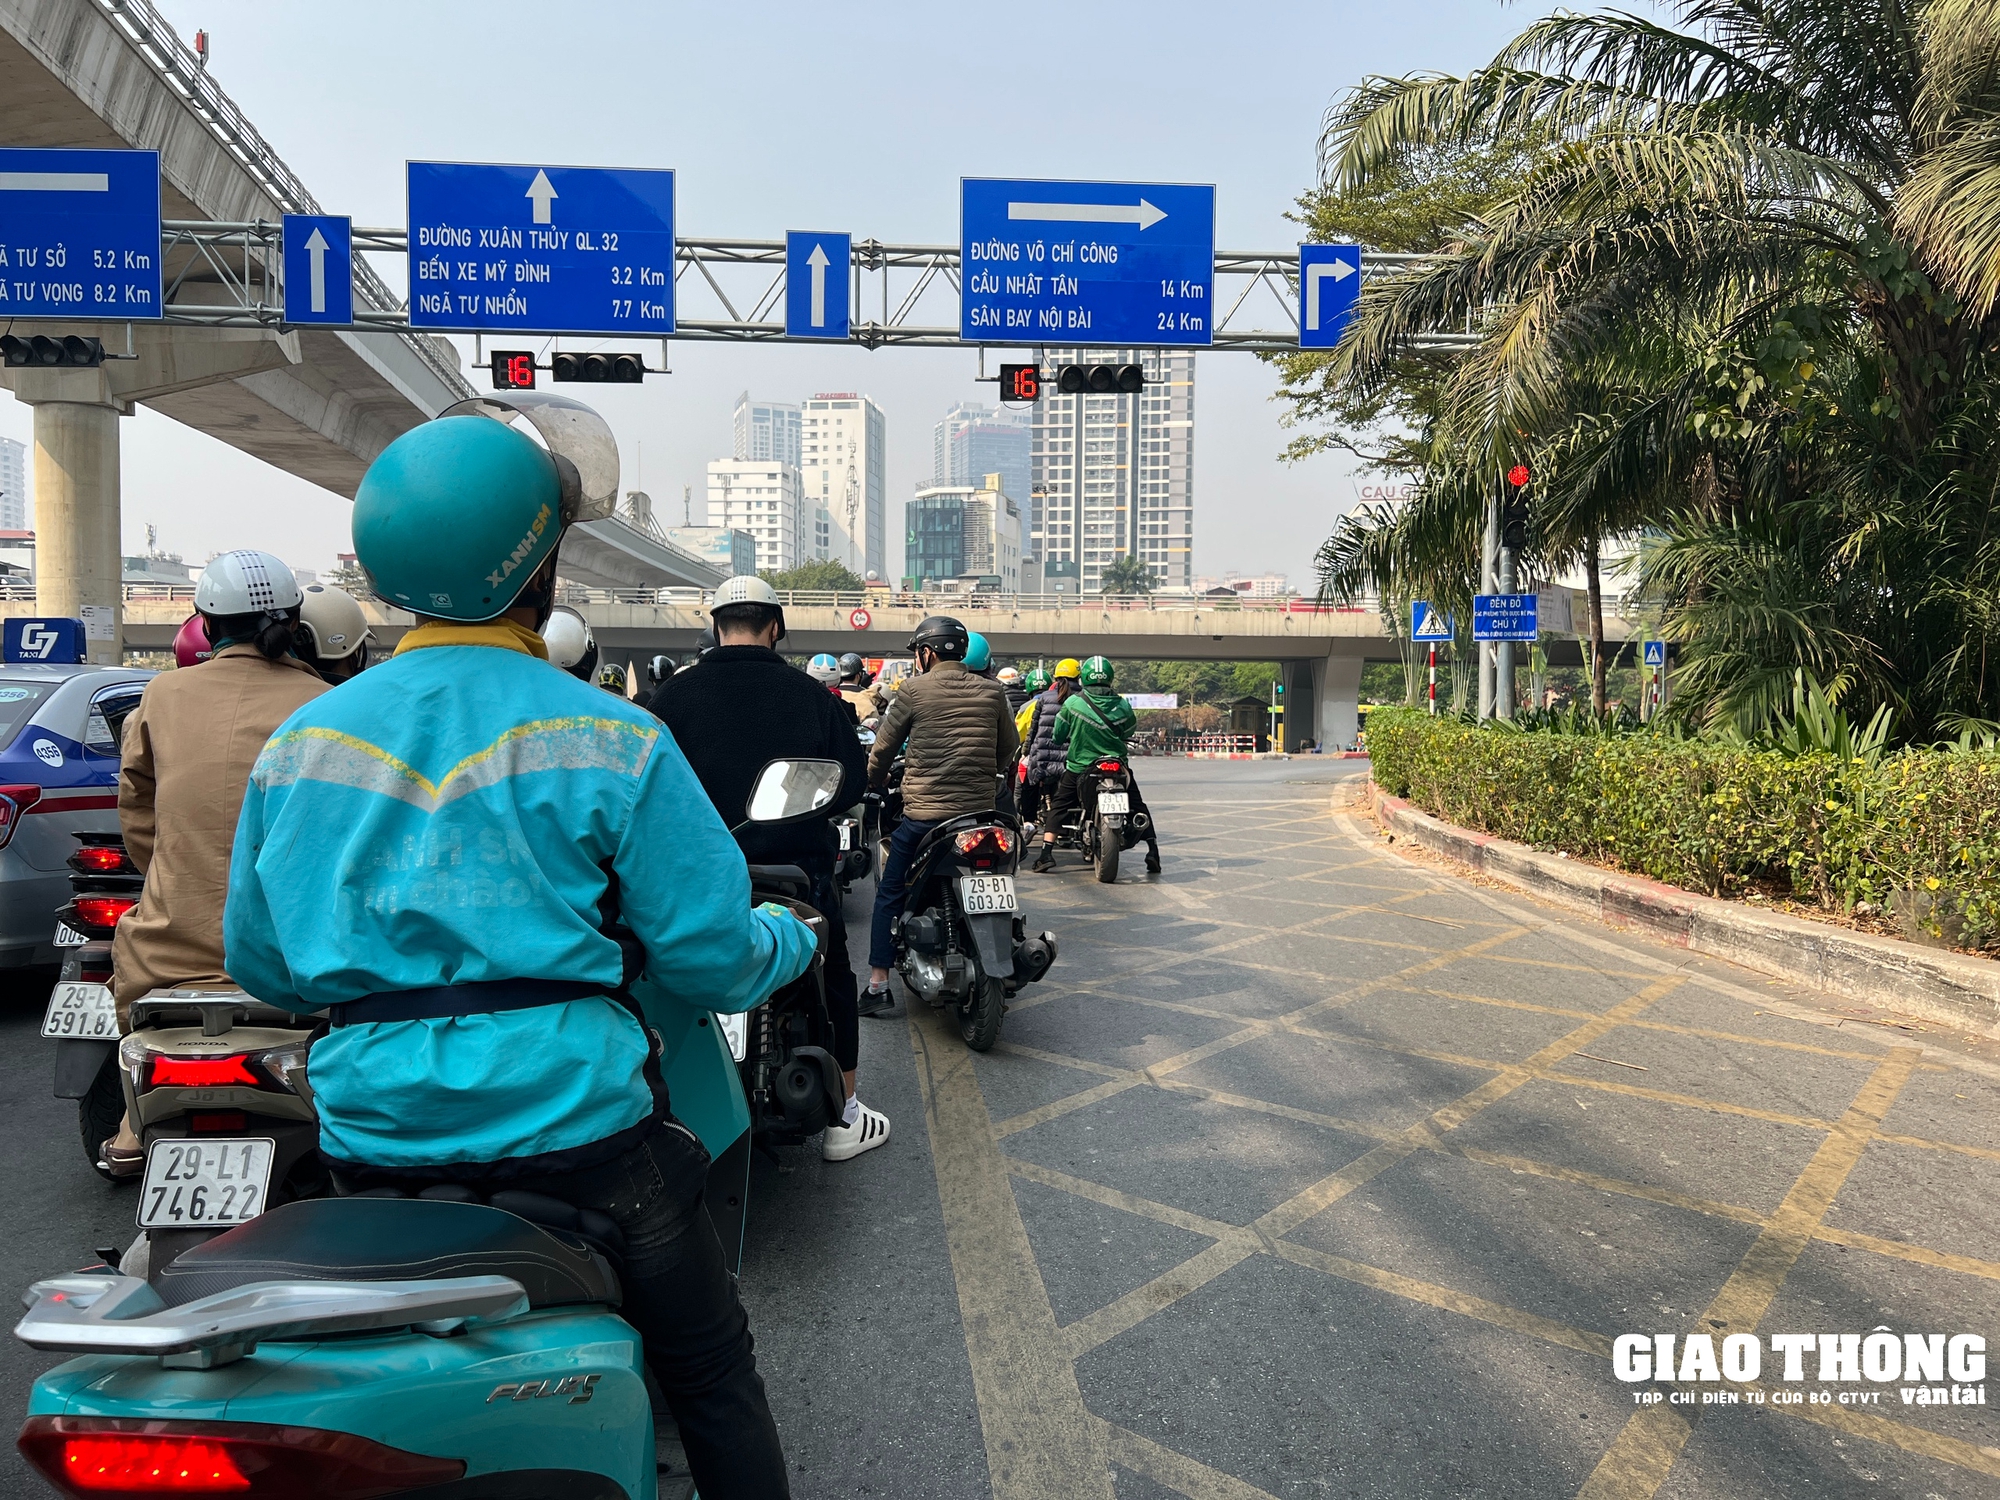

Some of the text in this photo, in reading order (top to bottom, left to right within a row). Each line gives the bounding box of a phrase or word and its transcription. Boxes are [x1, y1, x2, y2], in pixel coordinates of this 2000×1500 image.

[419, 223, 472, 247] ĐƯỜNG
[479, 226, 522, 249] XUÂN
[529, 225, 569, 250] THỦY
[16, 247, 38, 268] TƯ
[45, 242, 67, 268] SỞ
[94, 250, 116, 269] 5.2
[125, 250, 150, 269] Km
[971, 238, 1118, 264] ĐƯỜNG VÕ CHÍ CÔNG
[419, 253, 665, 286] BẾN XE MỸ ĐÌNH 3.2 Km
[13, 281, 36, 301] TƯ
[42, 283, 83, 306] VỌNG
[94, 284, 116, 303] 8.2
[125, 284, 151, 303] Km
[971, 268, 1204, 299] CẦU NHẬT TÂN 14 Km
[420, 288, 665, 319] NGÃ TƯ NHỔN 7.7 Km
[971, 305, 1203, 331] SÂN BAY NỘI BÀI 24 Km
[507, 356, 532, 386] 16
[1014, 369, 1037, 397] 16
[1489, 595, 1521, 608] ĐÈN ĐỎ
[1492, 617, 1518, 629] CHÚ Ý
[19, 651, 39, 659] TAXI
[1090, 672, 1108, 680] Grab
[0, 691, 26, 699] 356
[36, 745, 61, 760] 4356
[970, 877, 1007, 894] 29-B1
[968, 894, 1014, 911] 603.20
[164, 1145, 253, 1181] 29-L1
[147, 1184, 258, 1222] 746.22
